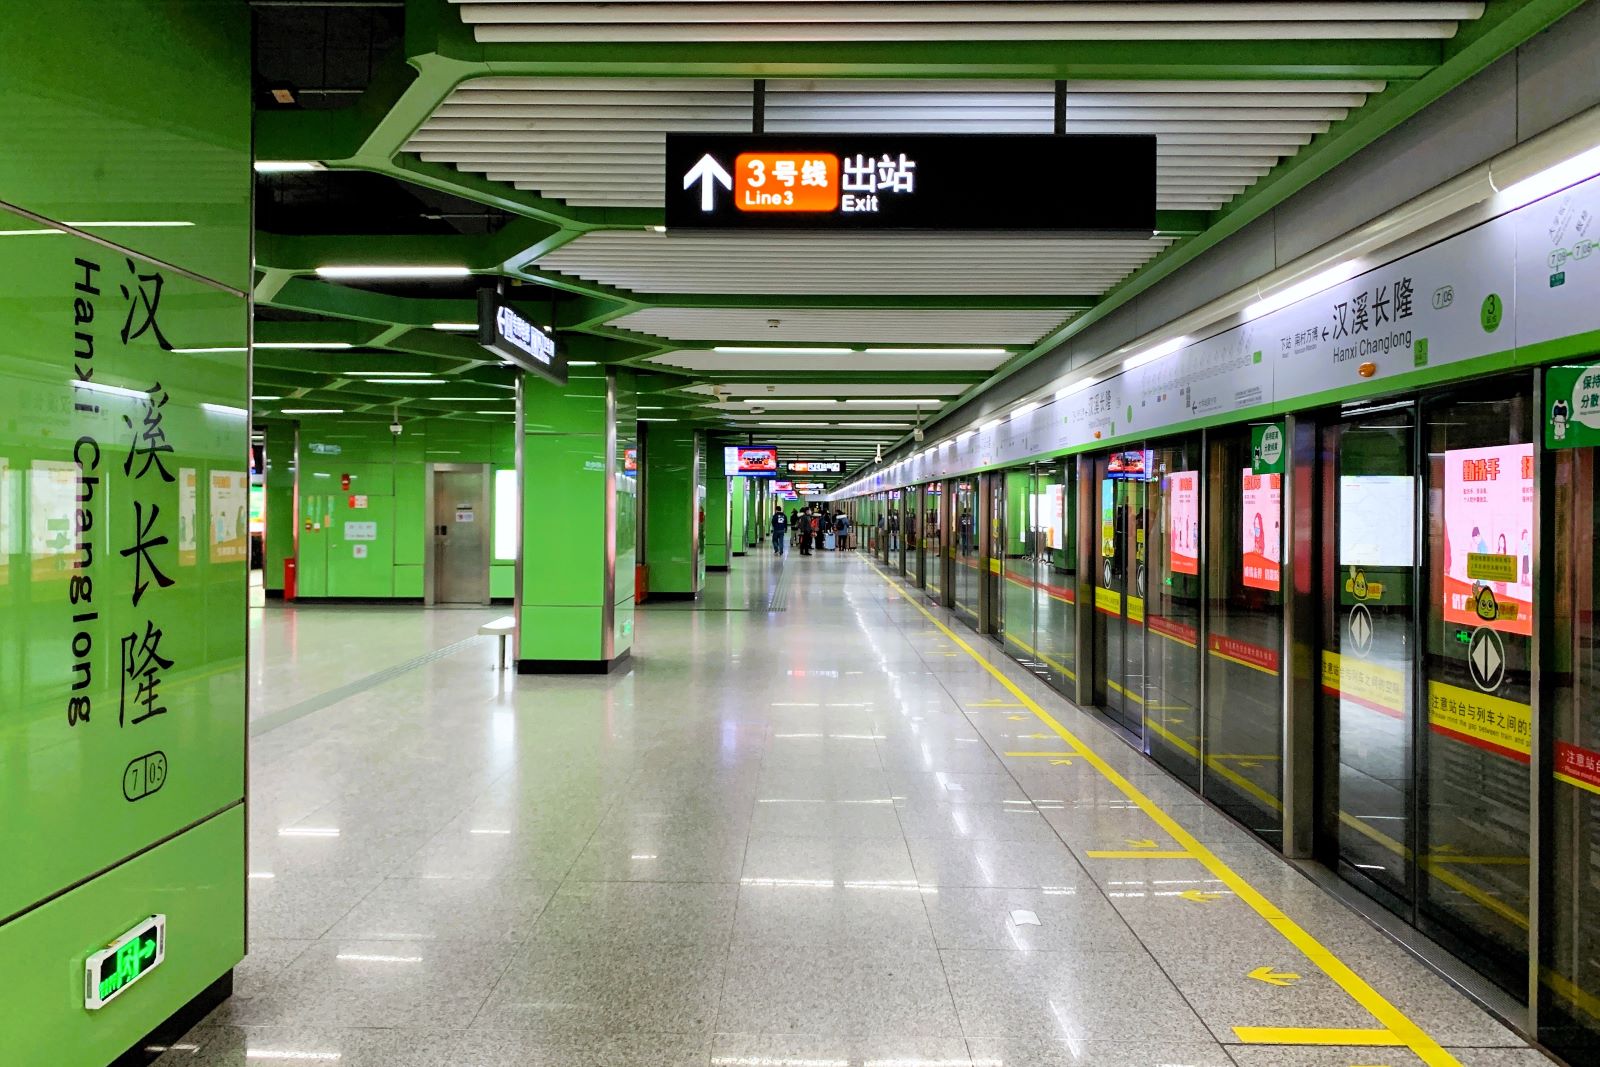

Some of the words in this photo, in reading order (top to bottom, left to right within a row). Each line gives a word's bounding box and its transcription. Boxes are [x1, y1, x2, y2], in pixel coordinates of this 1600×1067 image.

[747, 159, 828, 188] 3号线
[842, 153, 916, 193] 出站
[745, 190, 782, 206] Line
[783, 190, 794, 206] 3
[841, 194, 879, 212] Exit
[1332, 276, 1415, 341] 汉溪长隆
[73, 257, 101, 413] Hanxi
[1333, 342, 1358, 364] Hanxi
[1359, 330, 1412, 357] Changlong
[1463, 457, 1501, 482] 勤洗手
[120, 257, 176, 728] 汉溪长隆
[68, 435, 100, 727] Changlong
[132, 768, 139, 790] 7
[149, 758, 164, 784] 05
